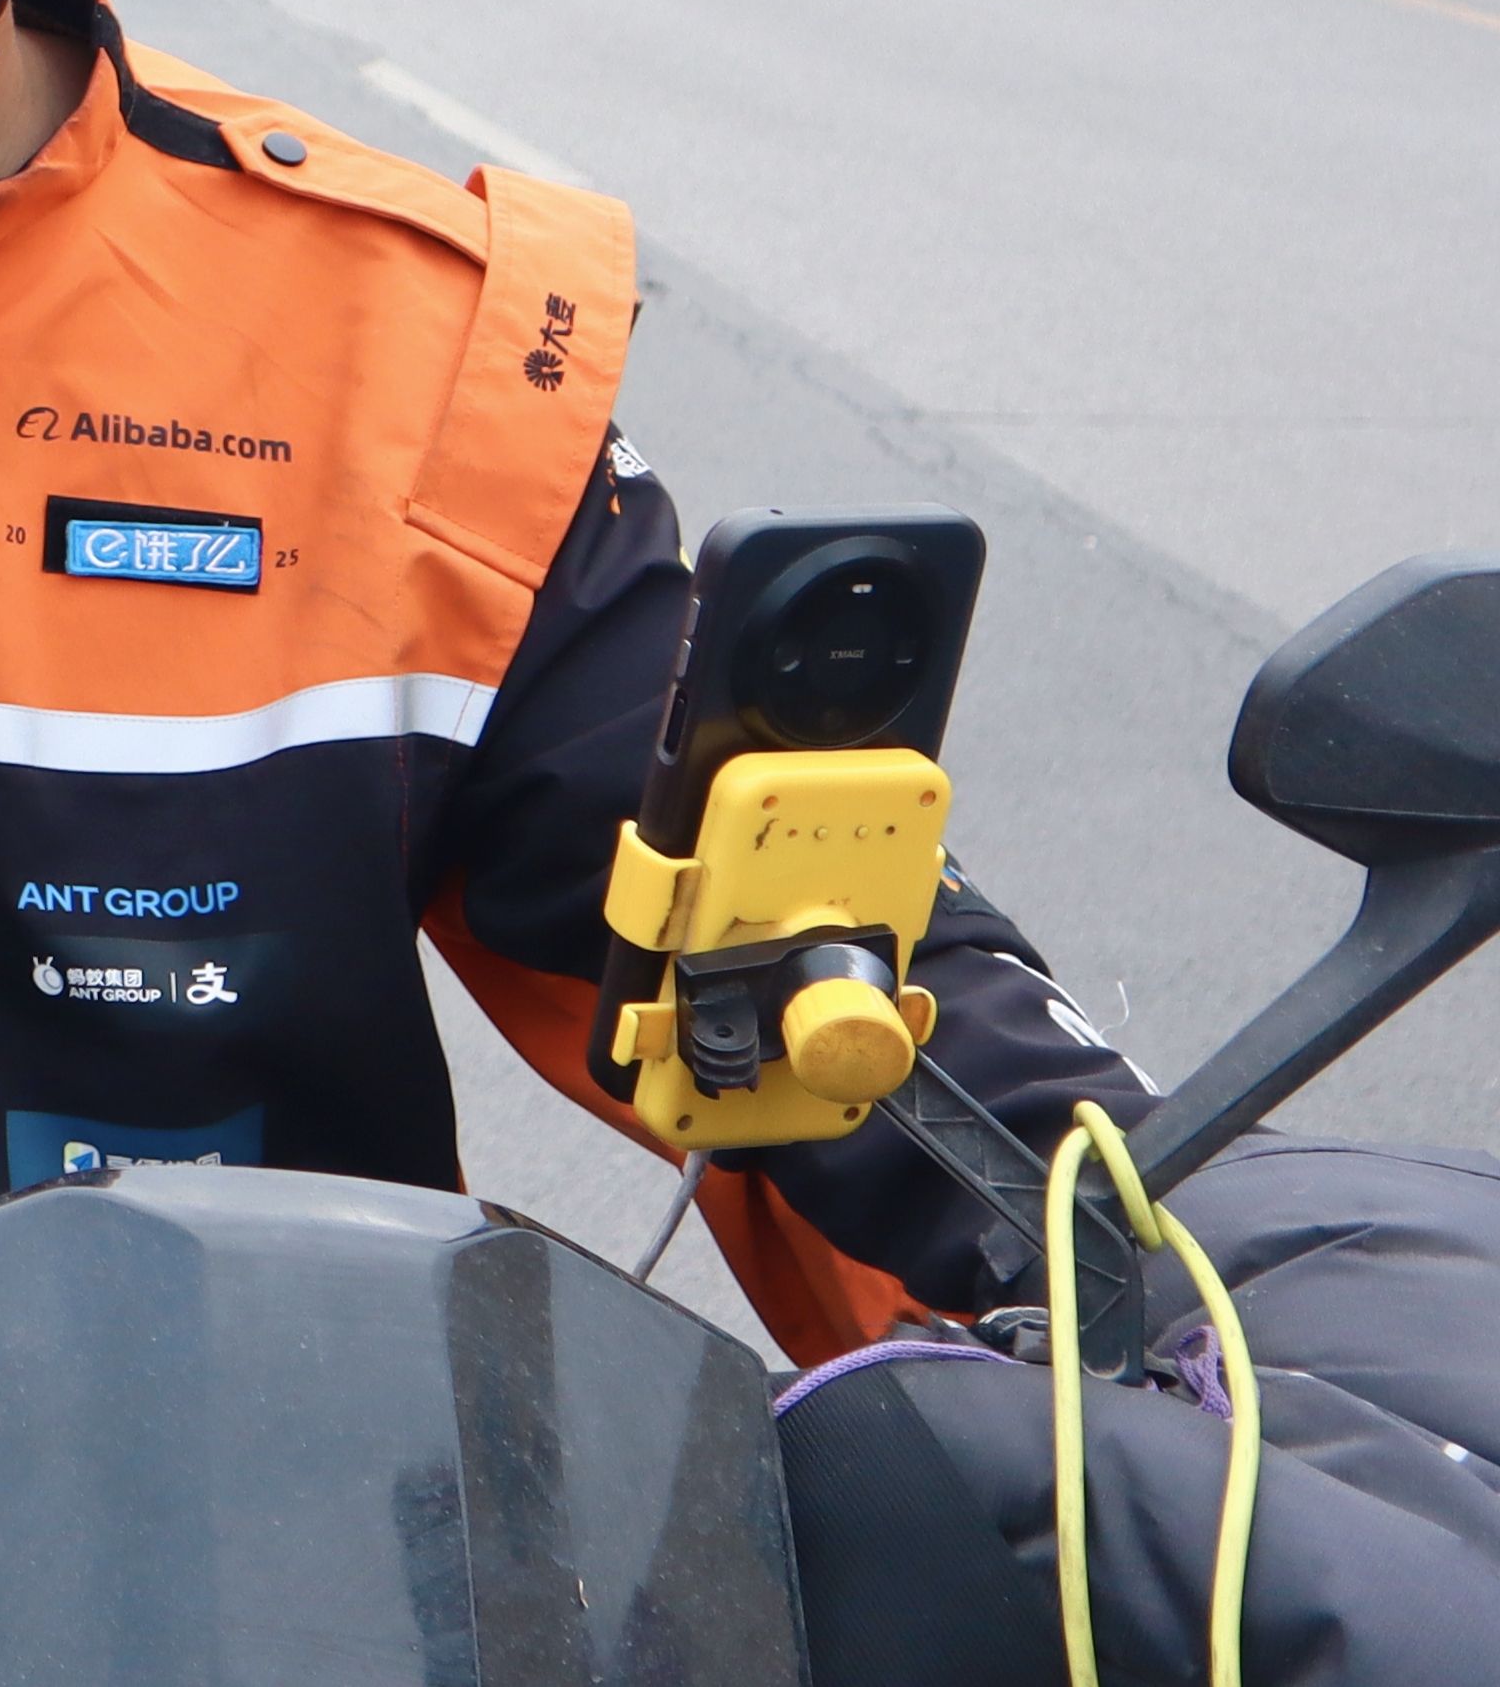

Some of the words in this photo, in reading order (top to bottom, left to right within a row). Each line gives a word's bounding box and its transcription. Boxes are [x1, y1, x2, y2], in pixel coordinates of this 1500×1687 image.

[540, 292, 577, 355] 大麦
[71, 412, 292, 462] Alibaba.com
[5, 524, 26, 544] 20
[275, 549, 300, 568] 25
[18, 882, 99, 912] ANT
[104, 881, 239, 918] GROUP
[66, 968, 143, 988] 蚂蚁集团
[69, 988, 101, 1001] ANT
[102, 988, 162, 1003] GROUP
